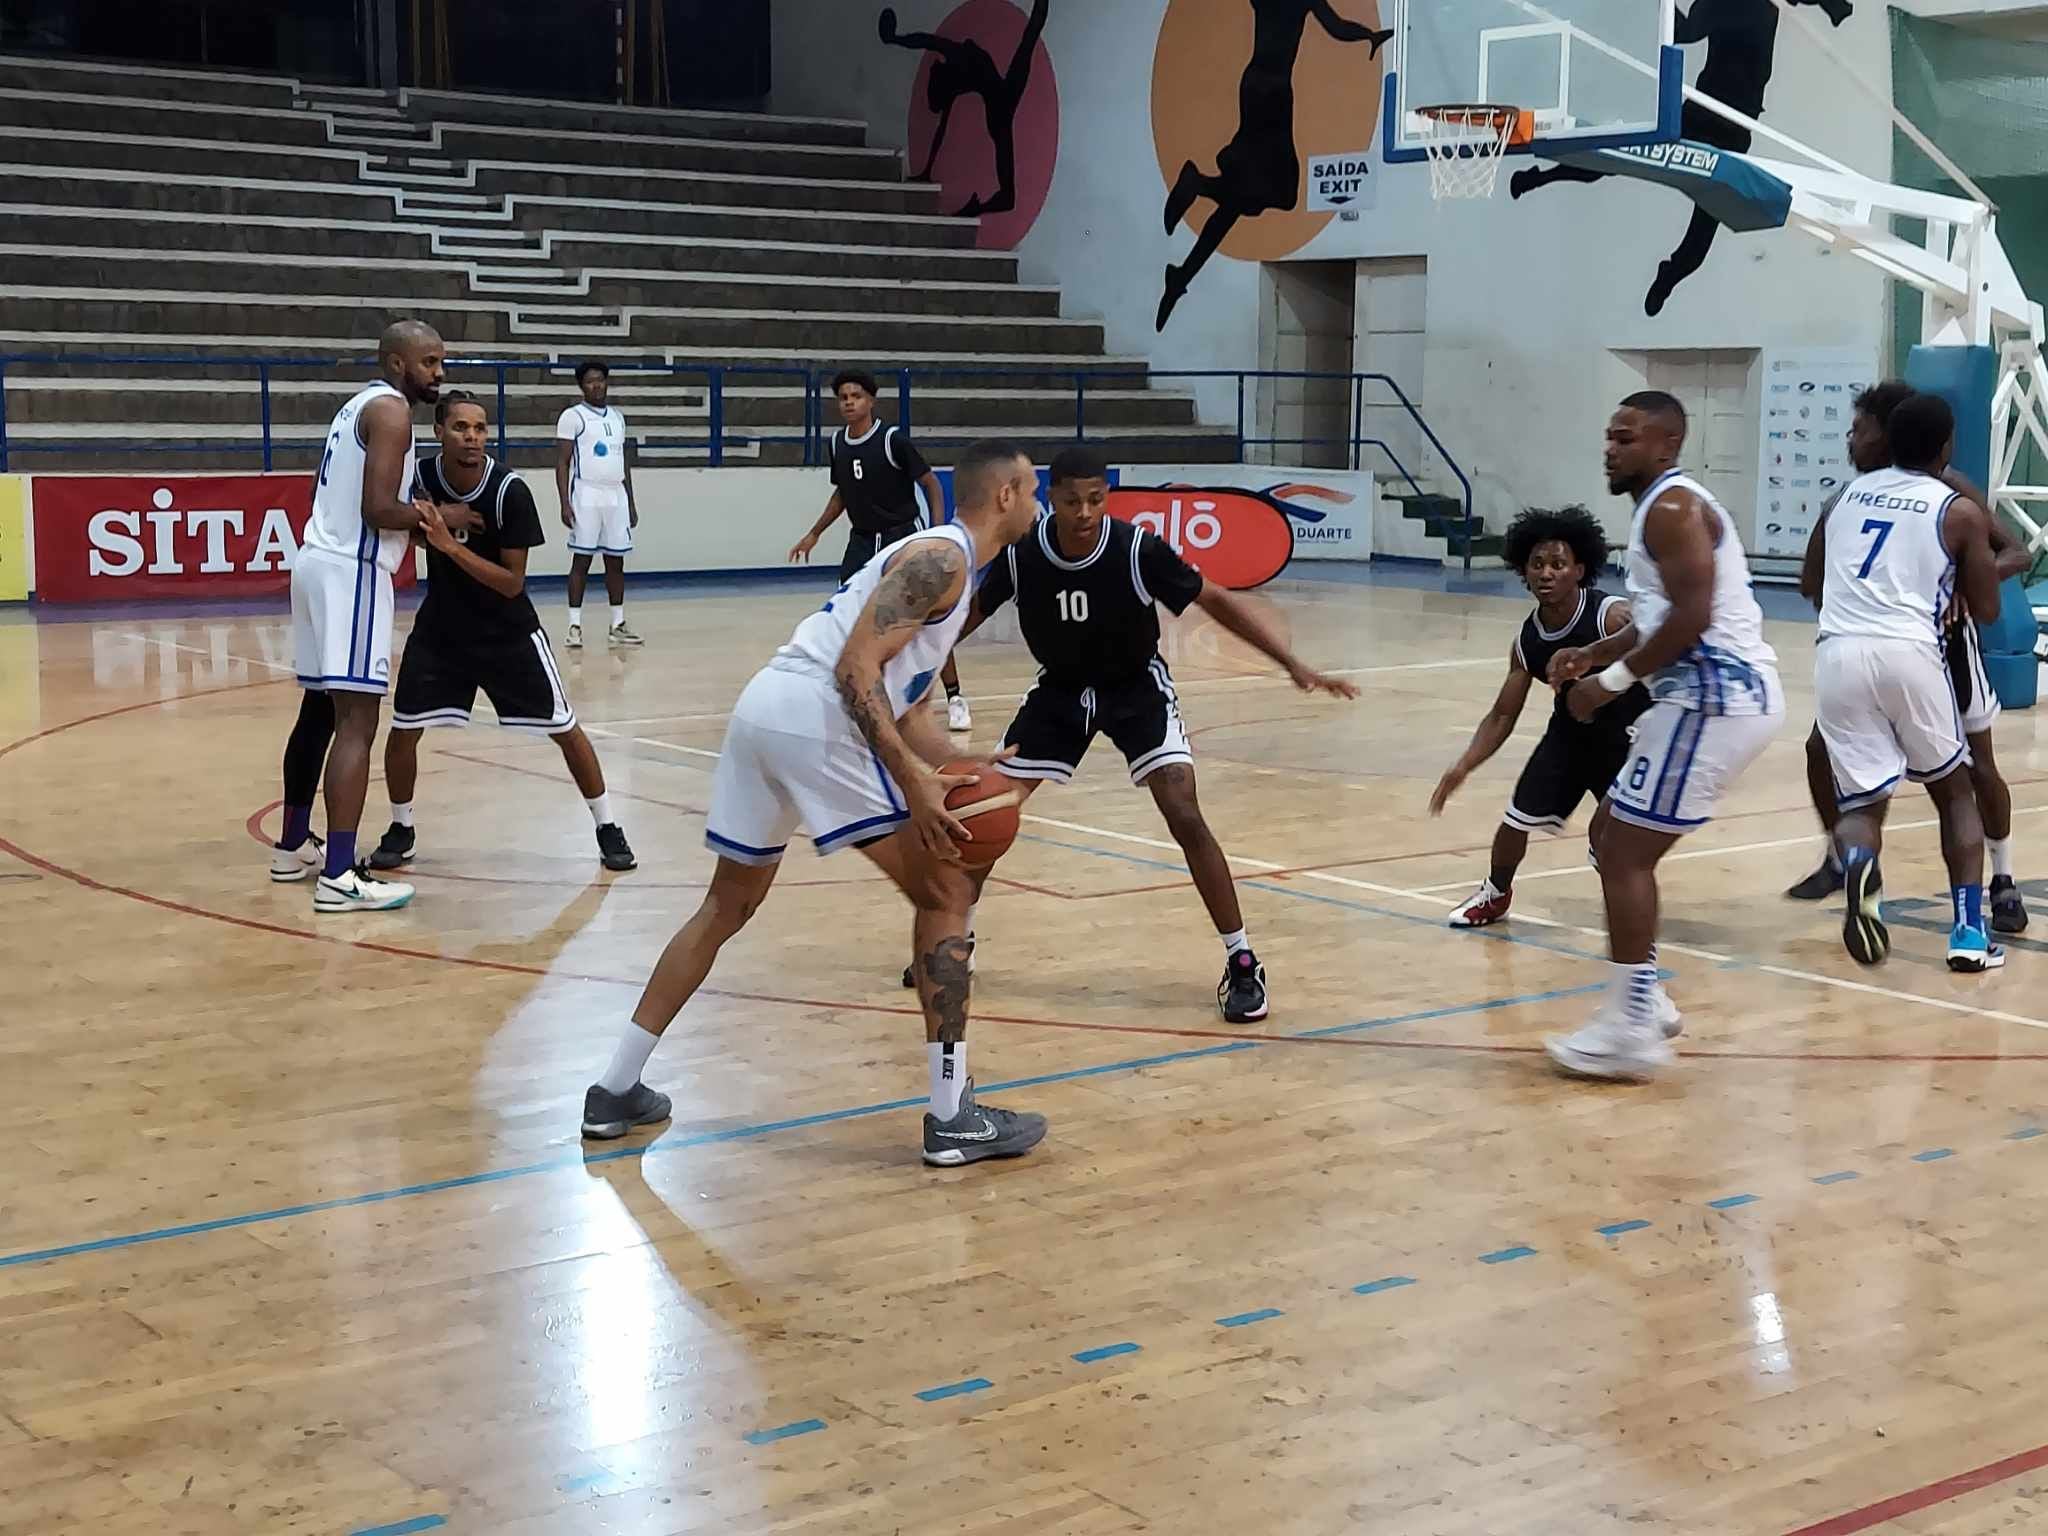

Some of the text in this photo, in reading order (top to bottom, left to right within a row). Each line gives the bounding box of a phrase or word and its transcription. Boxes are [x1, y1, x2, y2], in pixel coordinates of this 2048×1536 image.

[1320, 179, 1362, 194] EXIT
[1296, 527, 1353, 540] DUARTE
[1857, 518, 1895, 579] 7
[1056, 589, 1088, 622] 10
[1630, 756, 1649, 791] 8
